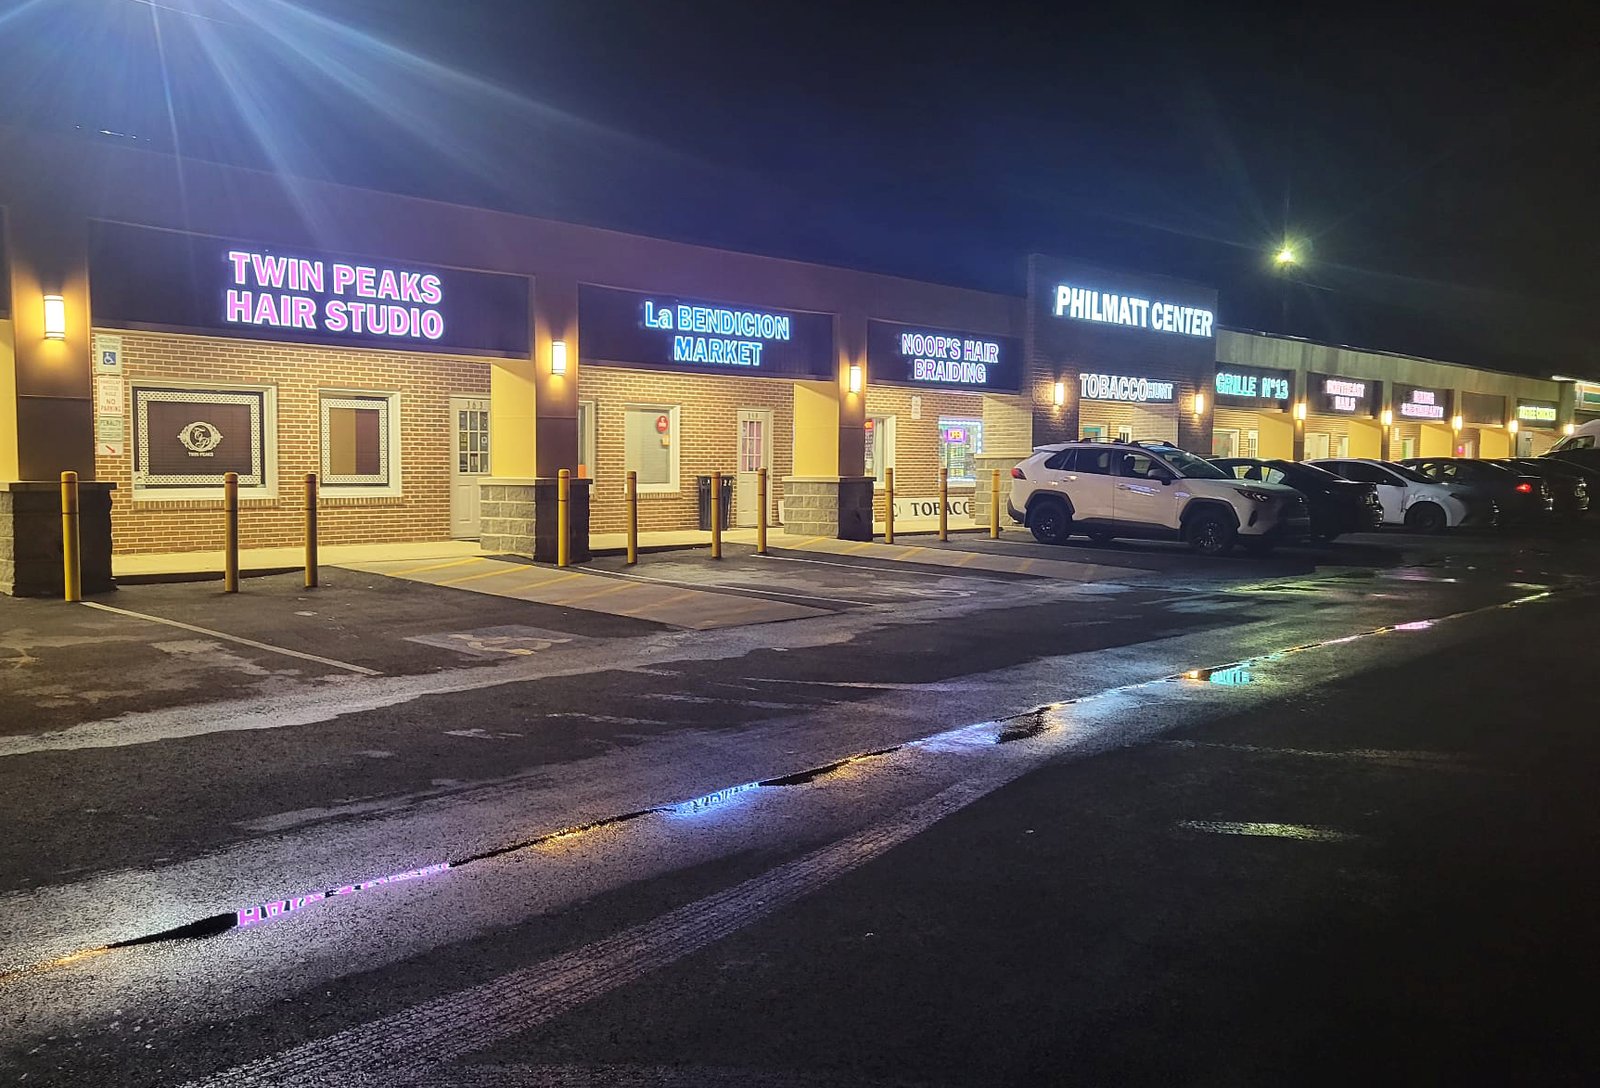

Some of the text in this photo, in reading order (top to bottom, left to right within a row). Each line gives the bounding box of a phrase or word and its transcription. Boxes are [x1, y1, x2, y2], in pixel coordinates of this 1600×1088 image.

[228, 251, 443, 305] TWIN PEAKS
[226, 289, 444, 340] HAIR STUDIO
[644, 301, 791, 341] La BENDICION
[1055, 285, 1214, 338] PHILMATT CENTER
[673, 336, 763, 367] MARKET
[901, 332, 1000, 364] NOOR'S HAIR
[913, 358, 987, 384] BRAIDING
[1215, 373, 1257, 398] GRILLE
[1079, 373, 1148, 402] TOBACCO
